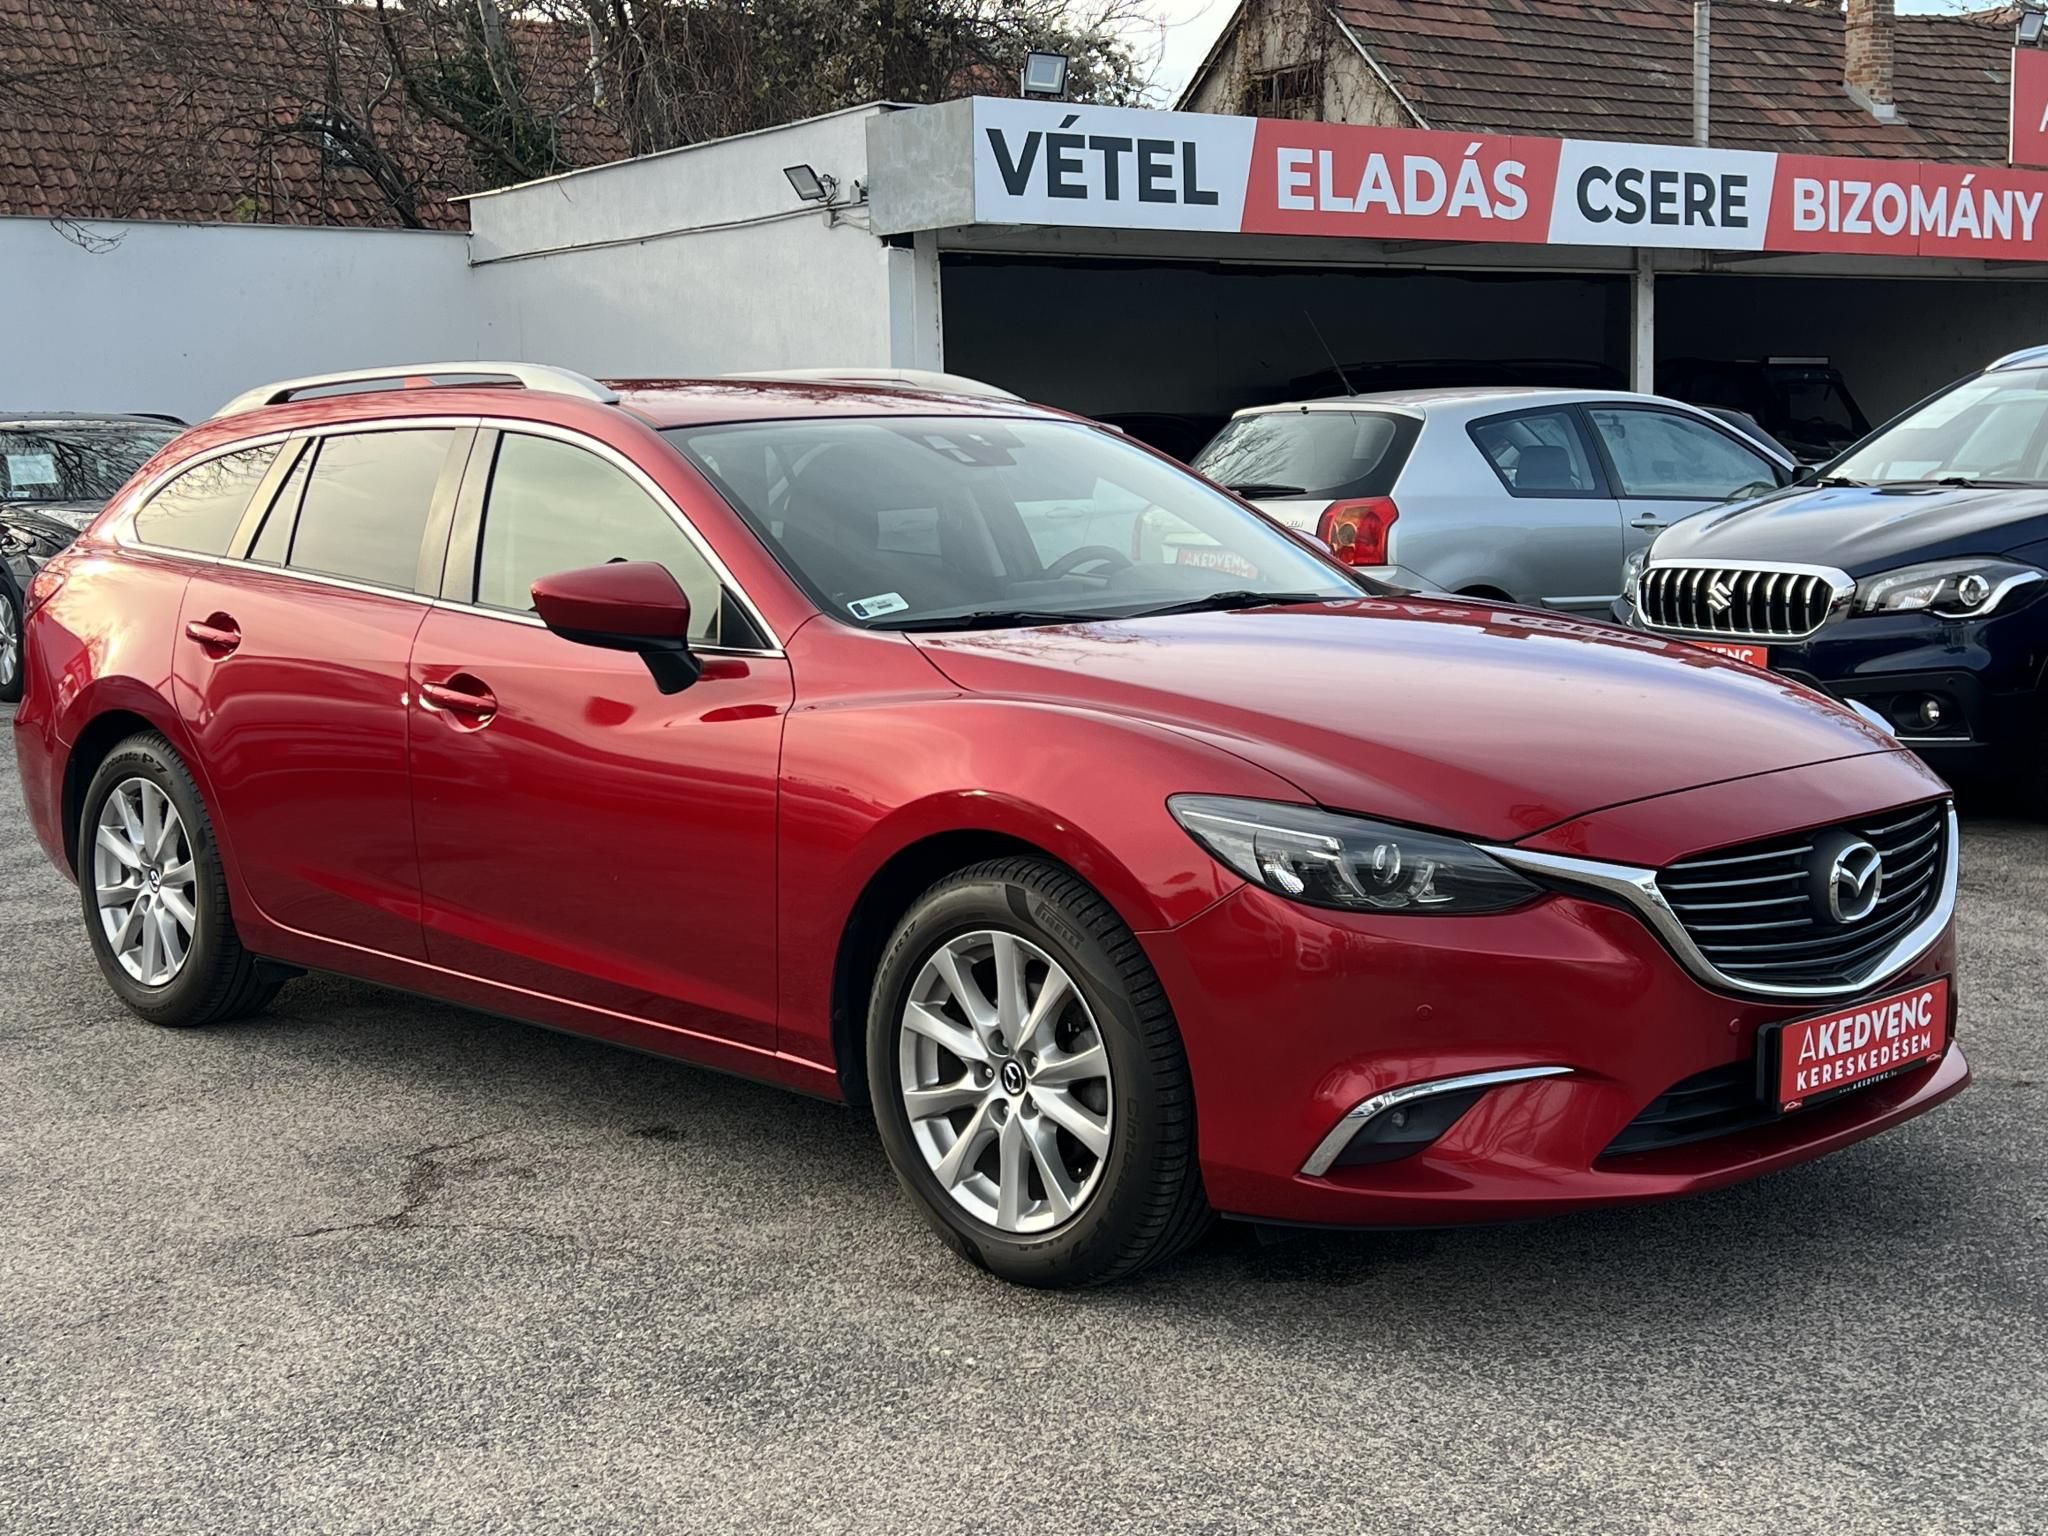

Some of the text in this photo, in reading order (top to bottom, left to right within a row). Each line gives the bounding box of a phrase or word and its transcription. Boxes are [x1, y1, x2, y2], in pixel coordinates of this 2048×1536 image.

[985, 114, 2043, 241] VÉTEL ELADÁS CSERE BIZOMÁNY
[1796, 1032, 1931, 1092] KERESKEDÉSEM
[1798, 992, 1932, 1066] AKEDVENC
